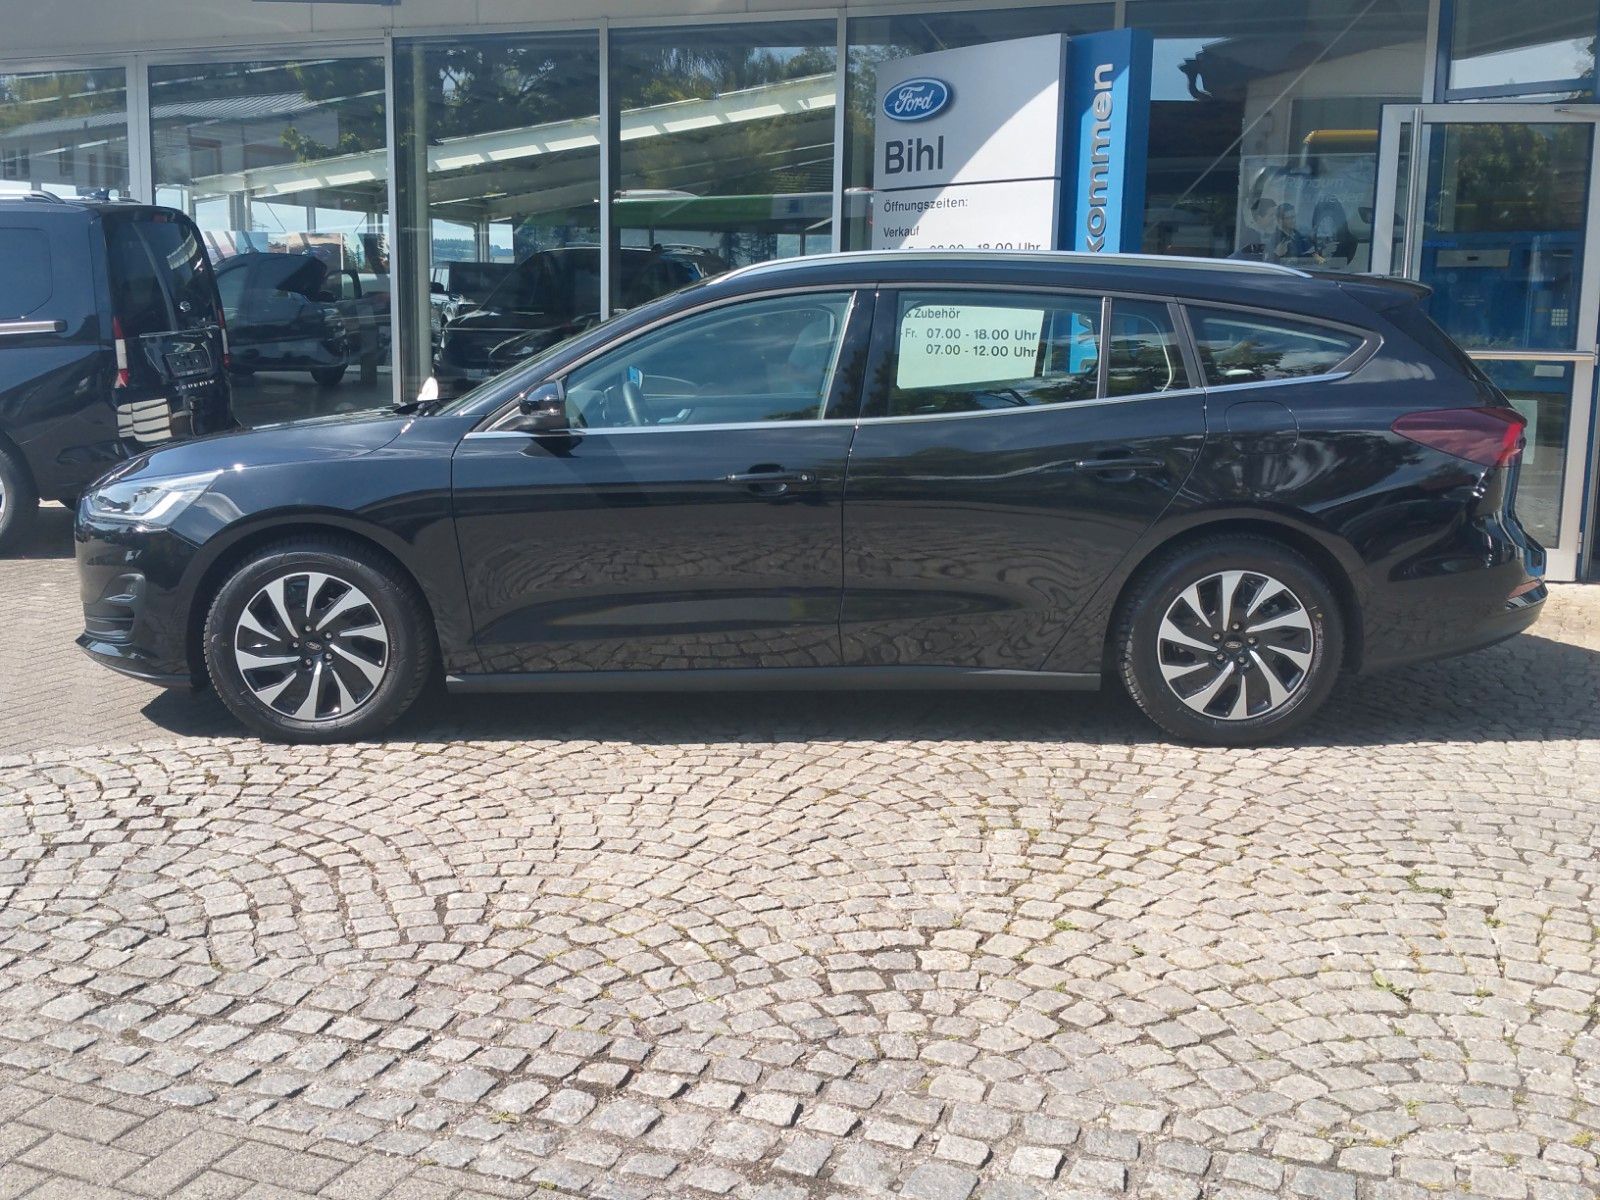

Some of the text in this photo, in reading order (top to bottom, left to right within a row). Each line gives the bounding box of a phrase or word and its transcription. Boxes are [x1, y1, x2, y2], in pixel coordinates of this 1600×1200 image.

[893, 84, 934, 113] Ford
[884, 135, 944, 175] Bihl
[883, 197, 968, 213] Öffnungszeiten:
[883, 225, 920, 238] Verkauf
[914, 307, 961, 319] Zubehör
[926, 328, 961, 339] 07.00
[973, 329, 1010, 340] 18.00
[1014, 329, 1037, 341] Uhr
[925, 344, 961, 355] 07.00
[973, 345, 1009, 357] 12.00
[1013, 346, 1037, 357] Uhr
